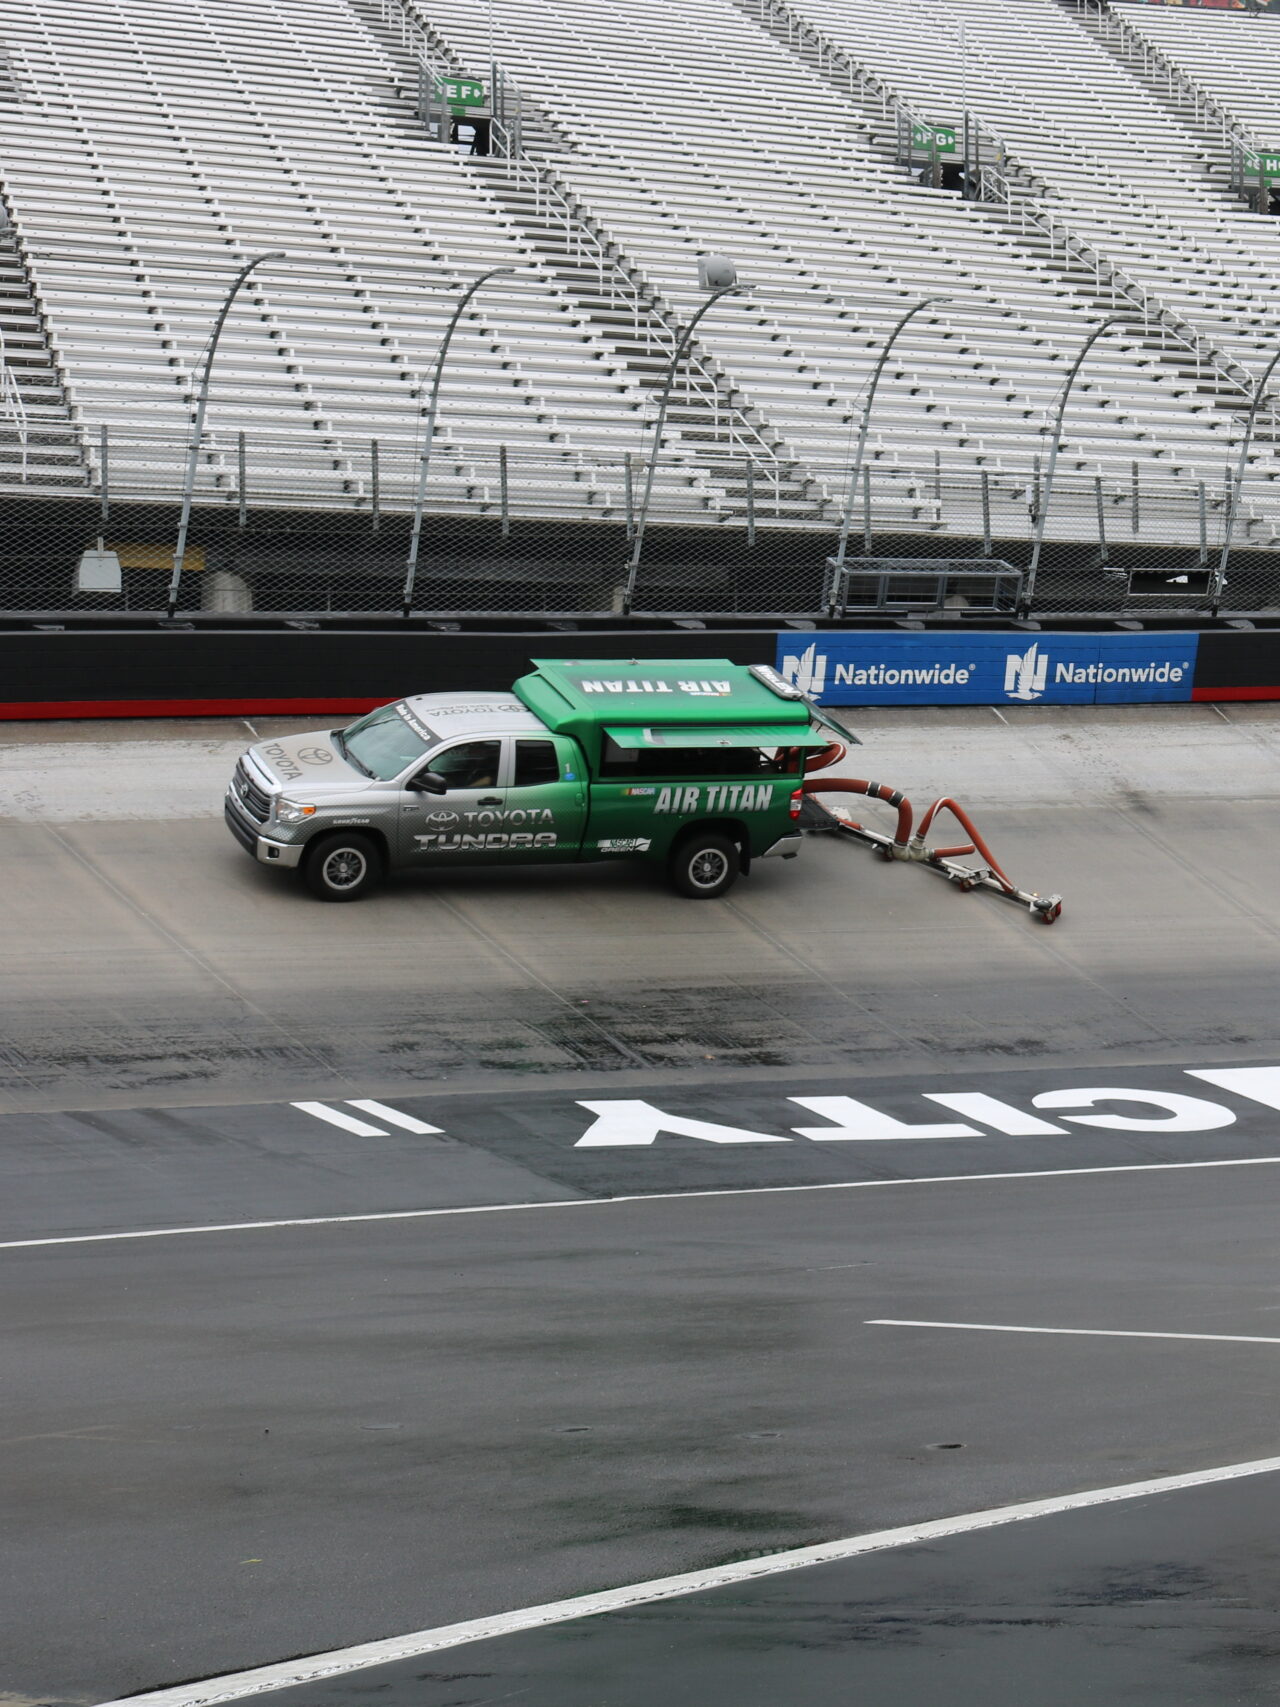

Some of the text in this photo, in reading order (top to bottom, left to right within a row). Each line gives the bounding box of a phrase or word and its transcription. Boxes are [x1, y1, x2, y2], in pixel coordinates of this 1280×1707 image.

[446, 85, 472, 98] E F
[936, 133, 946, 146] G
[1266, 159, 1278, 171] H
[581, 680, 731, 693] AIR TITAN
[429, 707, 494, 717] TOYOTA
[409, 720, 431, 741] America
[262, 743, 303, 781] TOYOTA
[653, 785, 774, 815] AIR TITAN
[464, 808, 555, 828] TOYOTA
[413, 832, 558, 850] TUNDRA
[573, 1087, 1238, 1147] CITY
